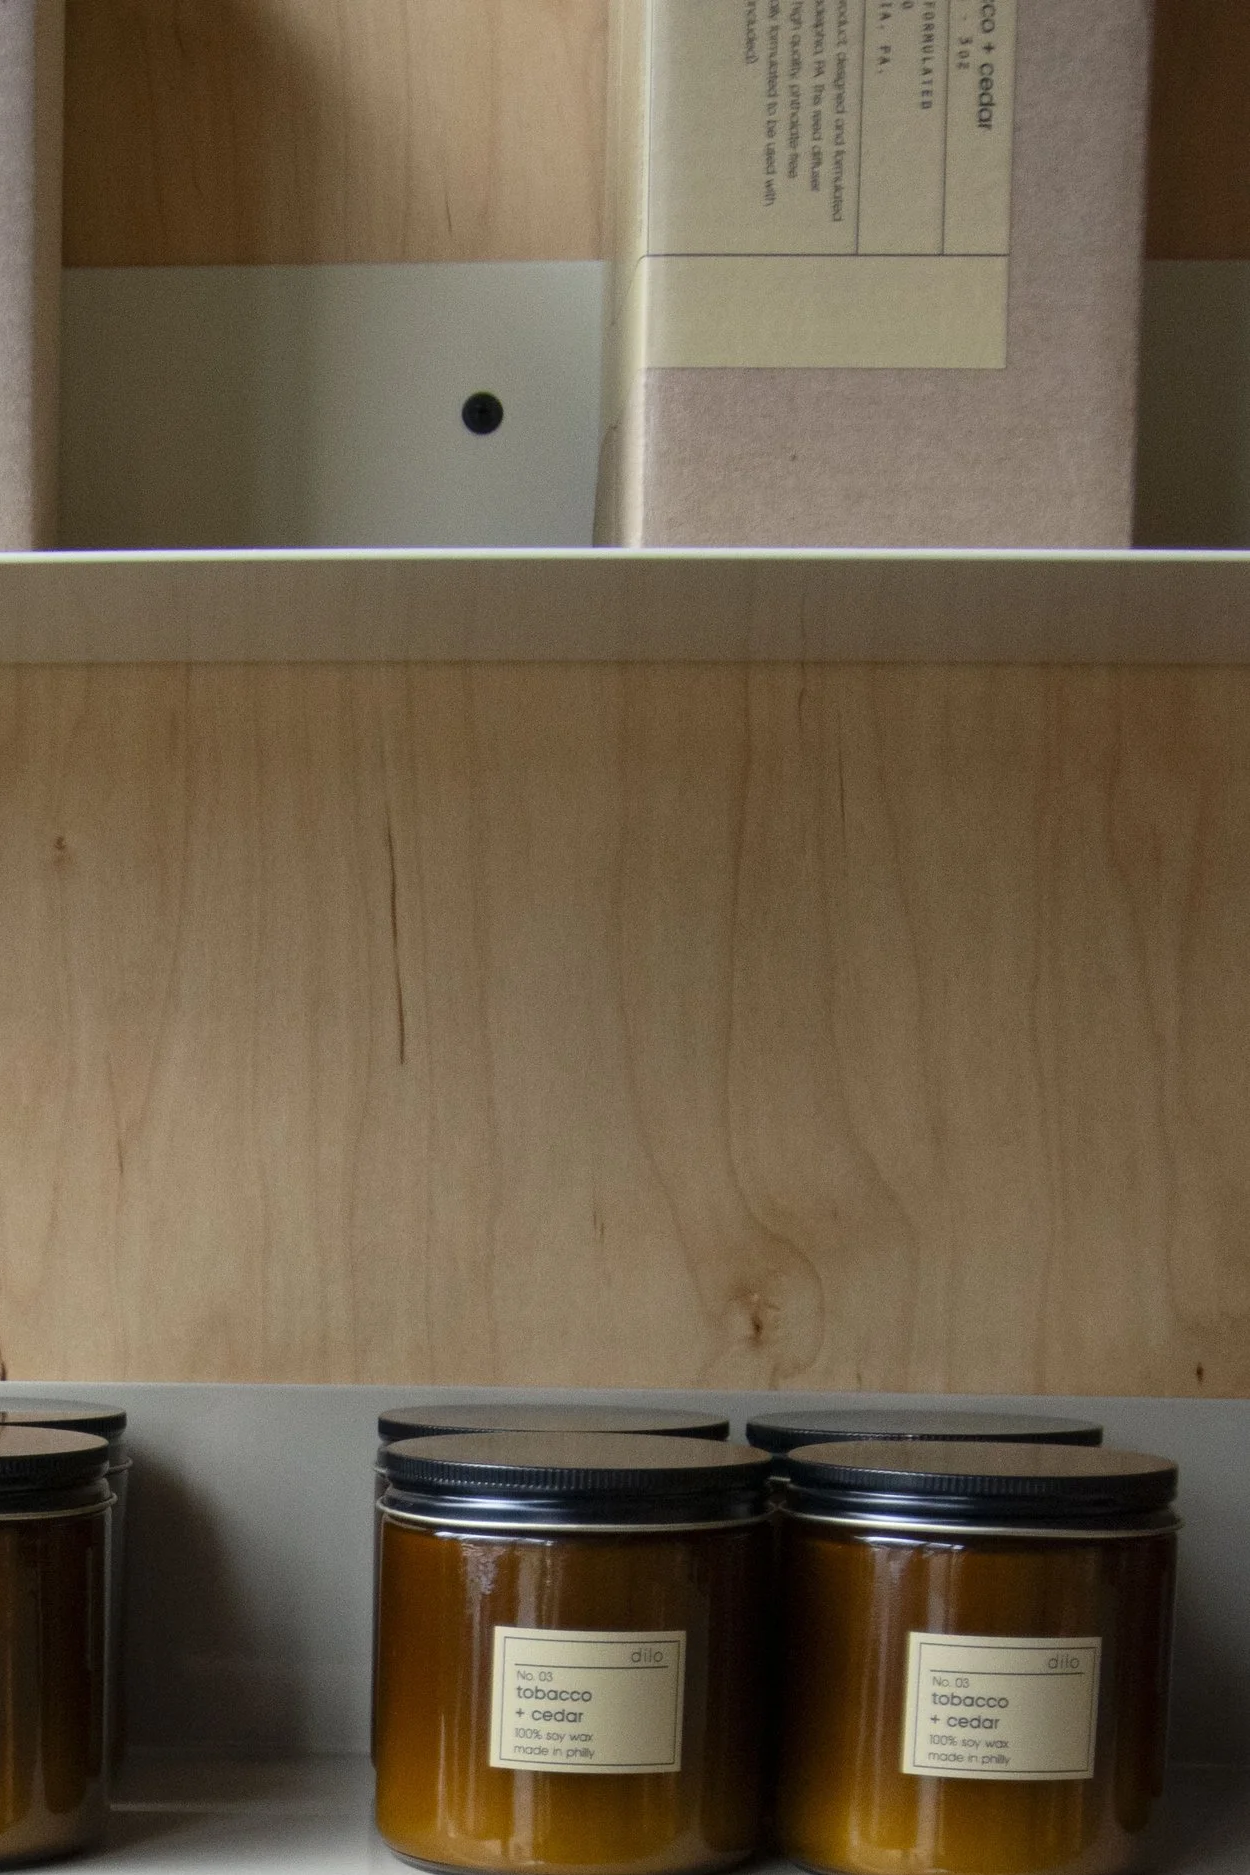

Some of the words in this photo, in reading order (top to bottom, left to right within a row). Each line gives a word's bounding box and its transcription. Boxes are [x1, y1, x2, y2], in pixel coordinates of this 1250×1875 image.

[981, 0, 996, 33] co
[920, 1, 936, 110] FORMULATED
[982, 43, 995, 54] +
[978, 62, 996, 130] cedar
[835, 118, 846, 146] and
[832, 150, 846, 222] formulated
[631, 1647, 664, 1664] dilo
[1047, 1654, 1080, 1669] dilo
[539, 1671, 554, 1682] 03
[932, 1675, 952, 1688] No.
[954, 1677, 970, 1689] 03
[516, 1685, 593, 1703] tobacco
[931, 1691, 1010, 1709] tobacco
[516, 1708, 525, 1718] +
[531, 1709, 584, 1723] cedar
[930, 1714, 940, 1725] +
[946, 1715, 1001, 1730] cedar
[514, 1727, 543, 1740] 100%
[546, 1730, 566, 1744] soy
[569, 1732, 594, 1743] wax
[929, 1734, 958, 1746] 100%
[961, 1736, 981, 1750] soy
[984, 1738, 1010, 1749] wax
[514, 1744, 550, 1756] made
[552, 1745, 563, 1757] in
[566, 1746, 596, 1760] philly
[928, 1750, 964, 1763] made
[967, 1752, 978, 1764] in
[981, 1752, 1012, 1767] philly
